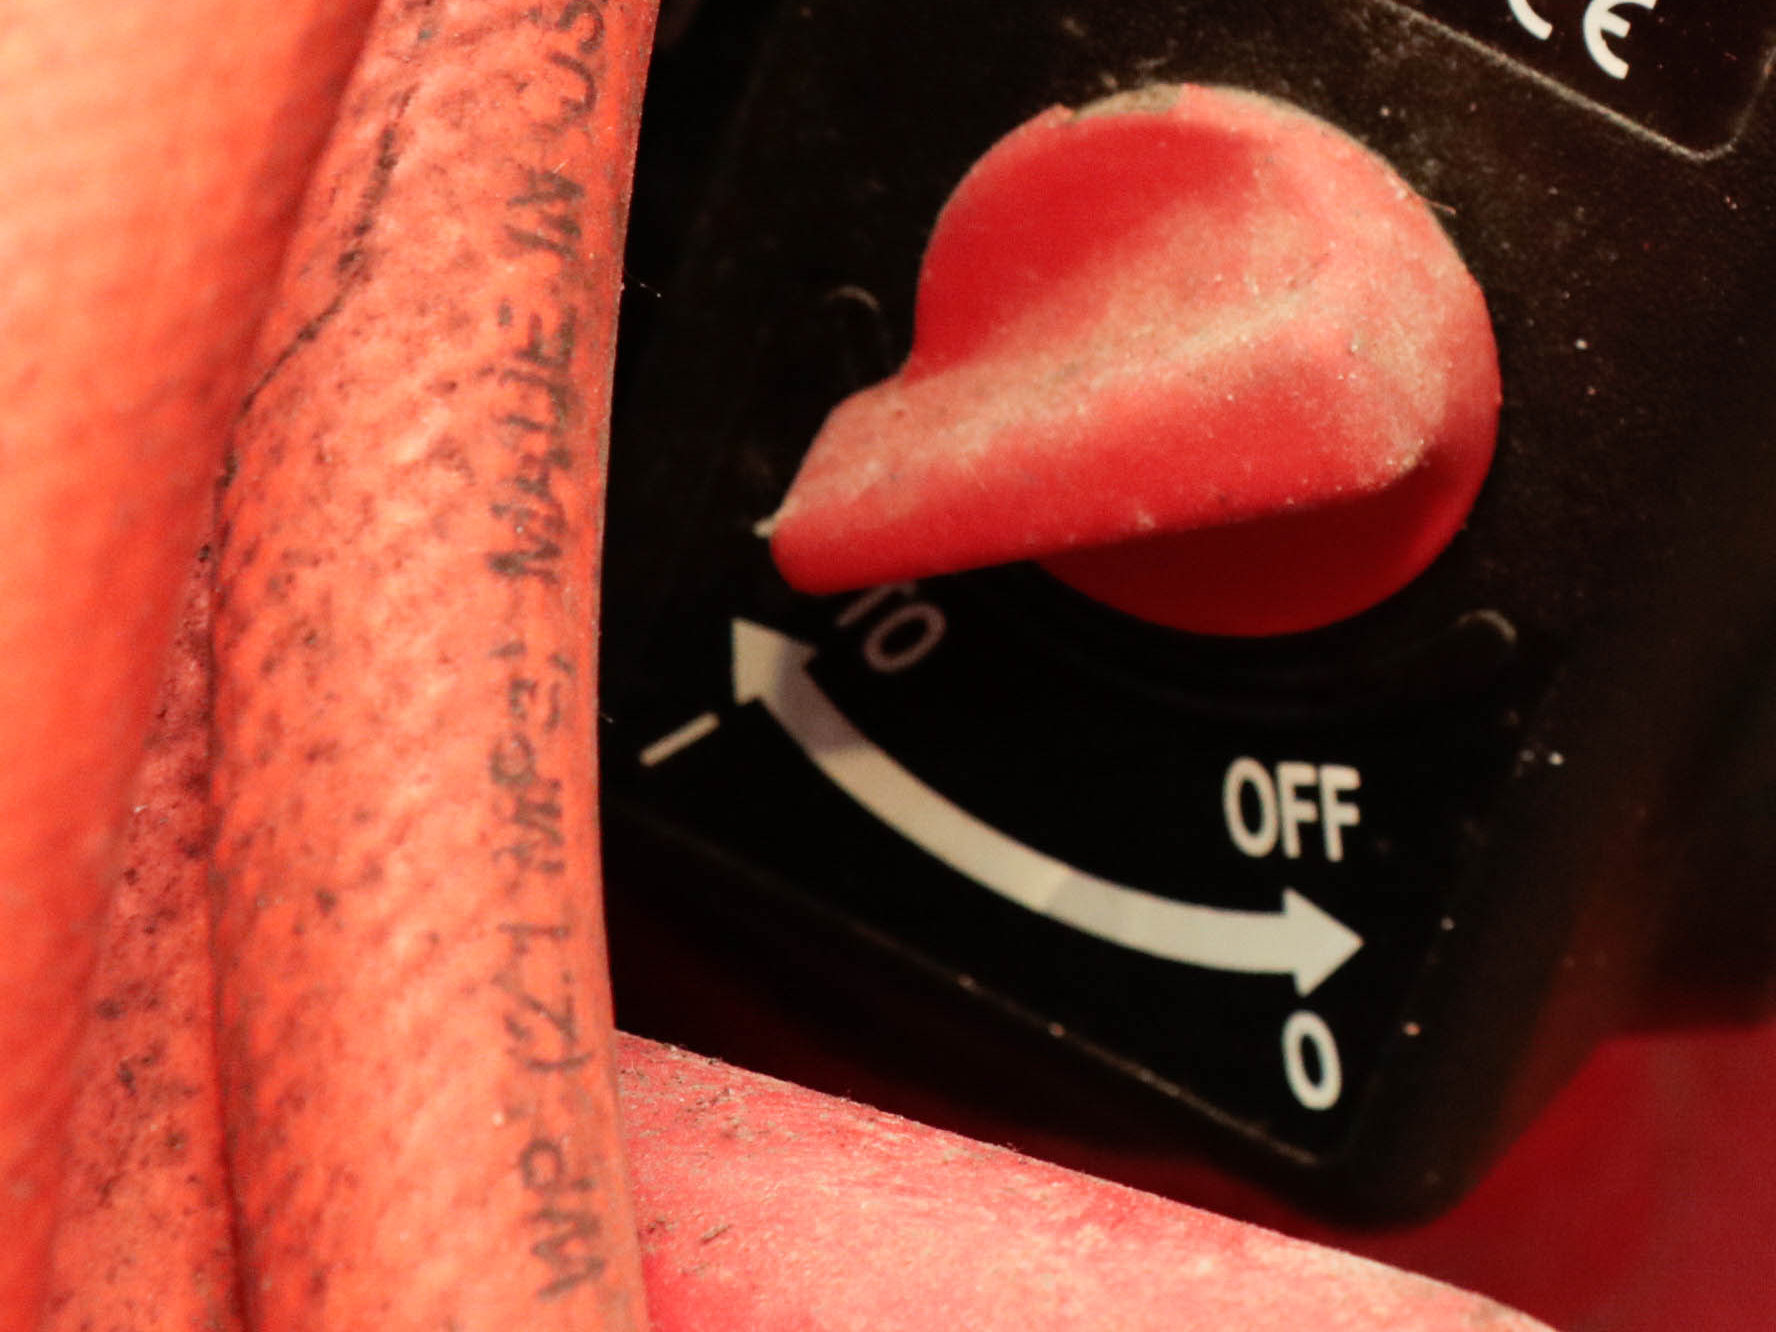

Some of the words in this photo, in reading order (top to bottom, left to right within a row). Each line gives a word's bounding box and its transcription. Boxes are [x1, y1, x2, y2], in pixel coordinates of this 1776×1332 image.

[504, 168, 585, 260] IN
[487, 307, 576, 584] MADE
[1223, 756, 1362, 863] OFF
[519, 1136, 605, 1299] WP
